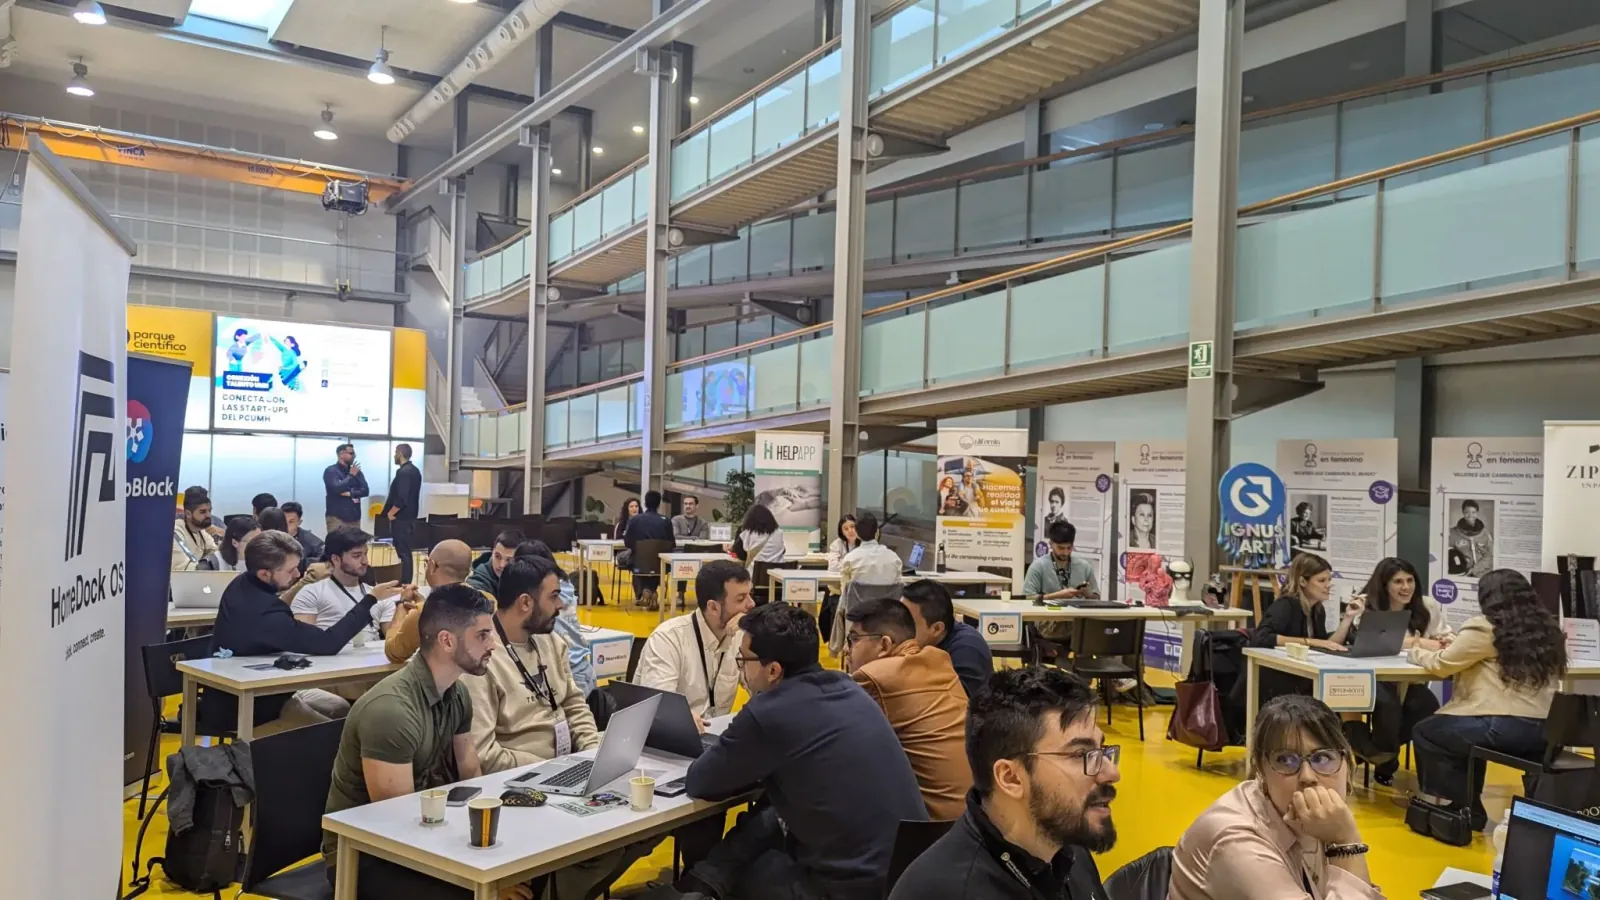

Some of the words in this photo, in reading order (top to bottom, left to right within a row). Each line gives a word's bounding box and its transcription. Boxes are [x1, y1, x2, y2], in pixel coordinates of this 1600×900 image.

[116, 144, 145, 156] VINCA
[133, 331, 175, 342] parque
[222, 394, 265, 402] CONECTA
[266, 396, 285, 404] ON
[240, 405, 288, 413] START-UPS
[222, 413, 236, 421] DEL
[1499, 456, 1540, 464] femenino
[1566, 465, 1599, 479] ZIP
[986, 491, 1021, 499] realidad
[1000, 499, 1021, 507] viaje
[1224, 522, 1284, 538] IGNUS
[1240, 539, 1274, 555] ART
[51, 568, 106, 628] HomeDock
[110, 561, 124, 597] OS
